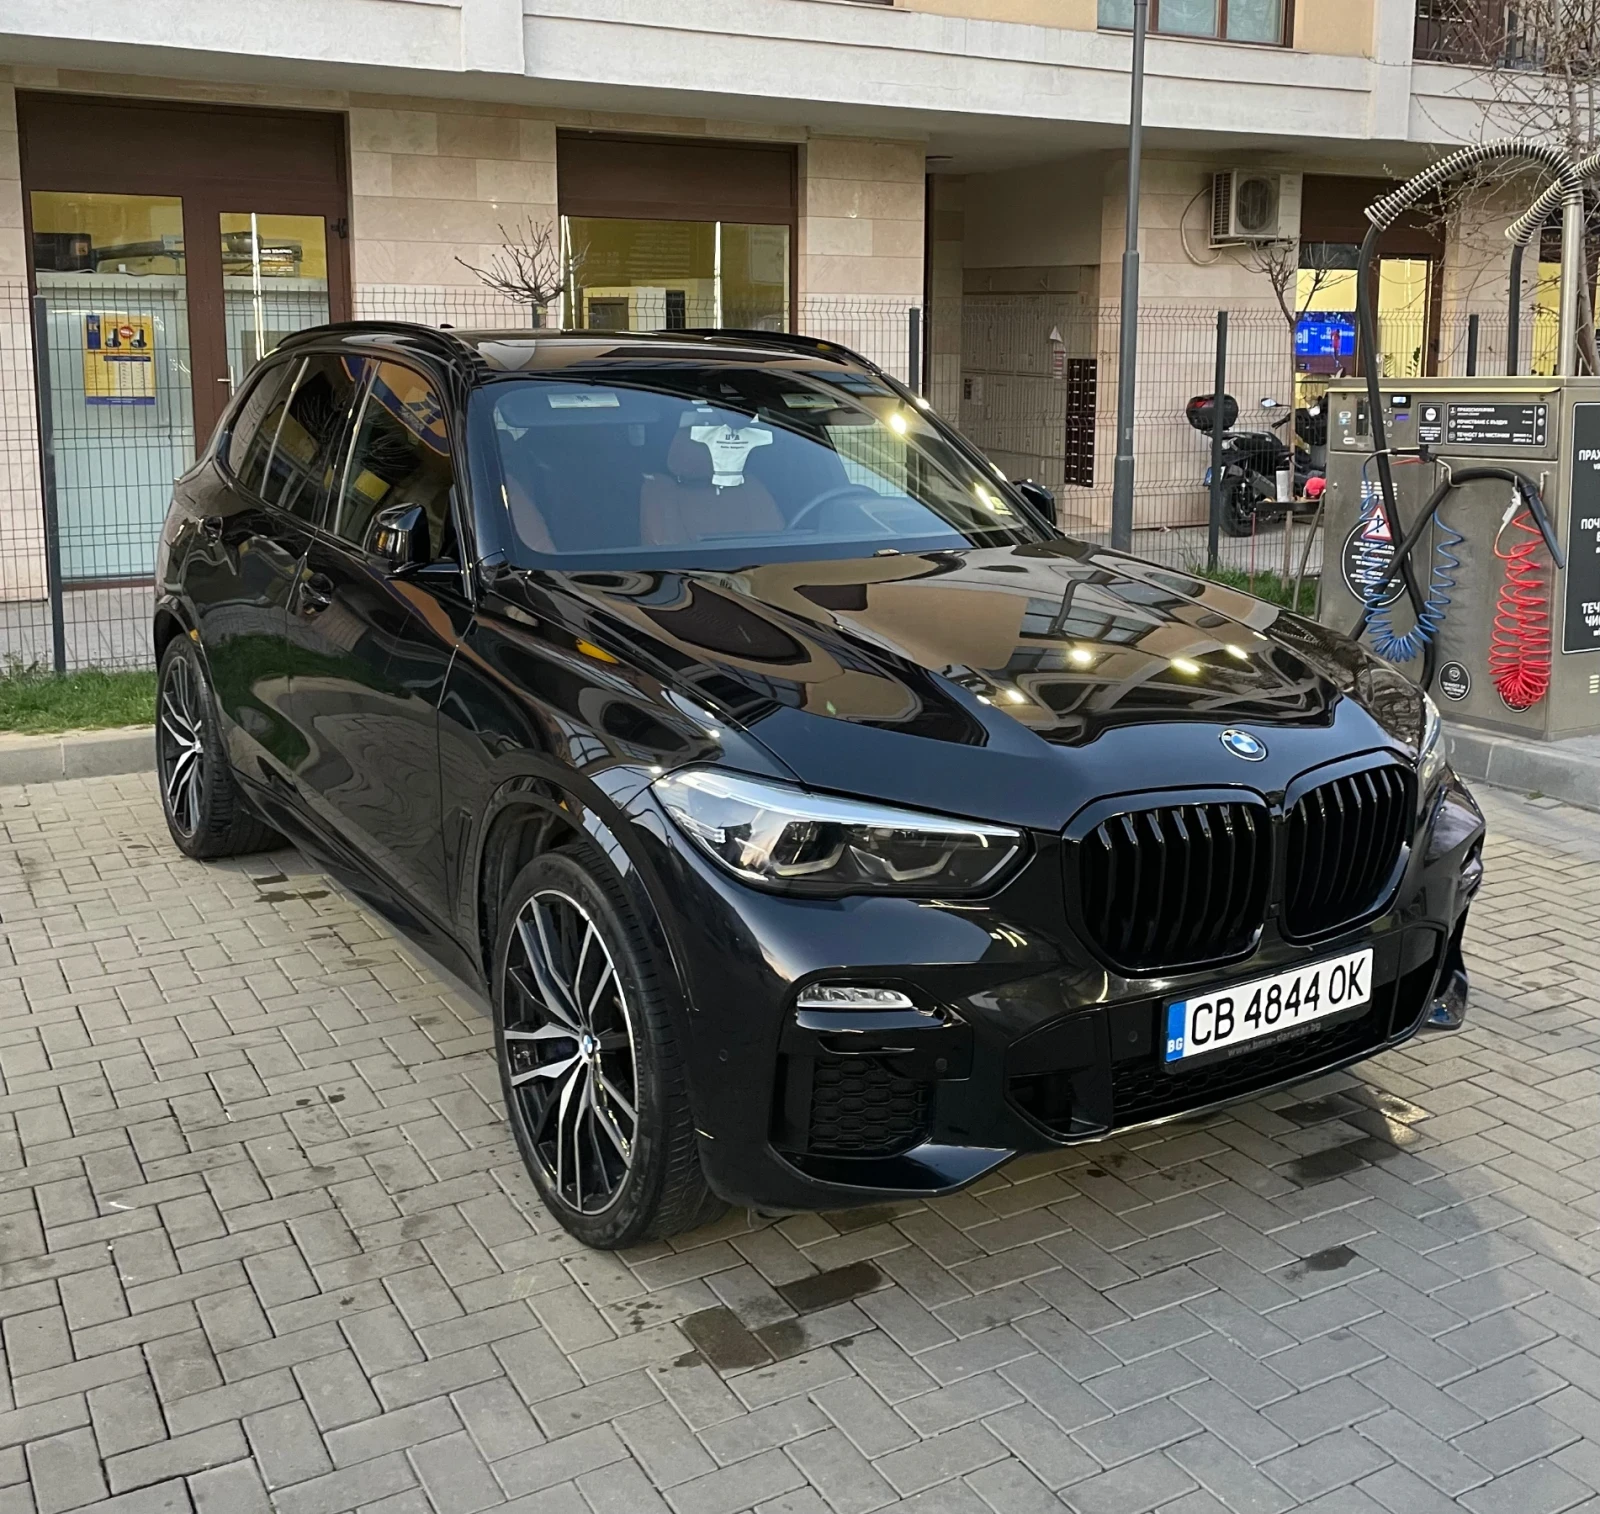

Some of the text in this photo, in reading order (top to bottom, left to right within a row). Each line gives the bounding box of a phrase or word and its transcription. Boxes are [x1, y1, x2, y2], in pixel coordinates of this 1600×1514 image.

[1191, 957, 1365, 1046] CB 4844 OK
[1167, 1037, 1183, 1053] BG
